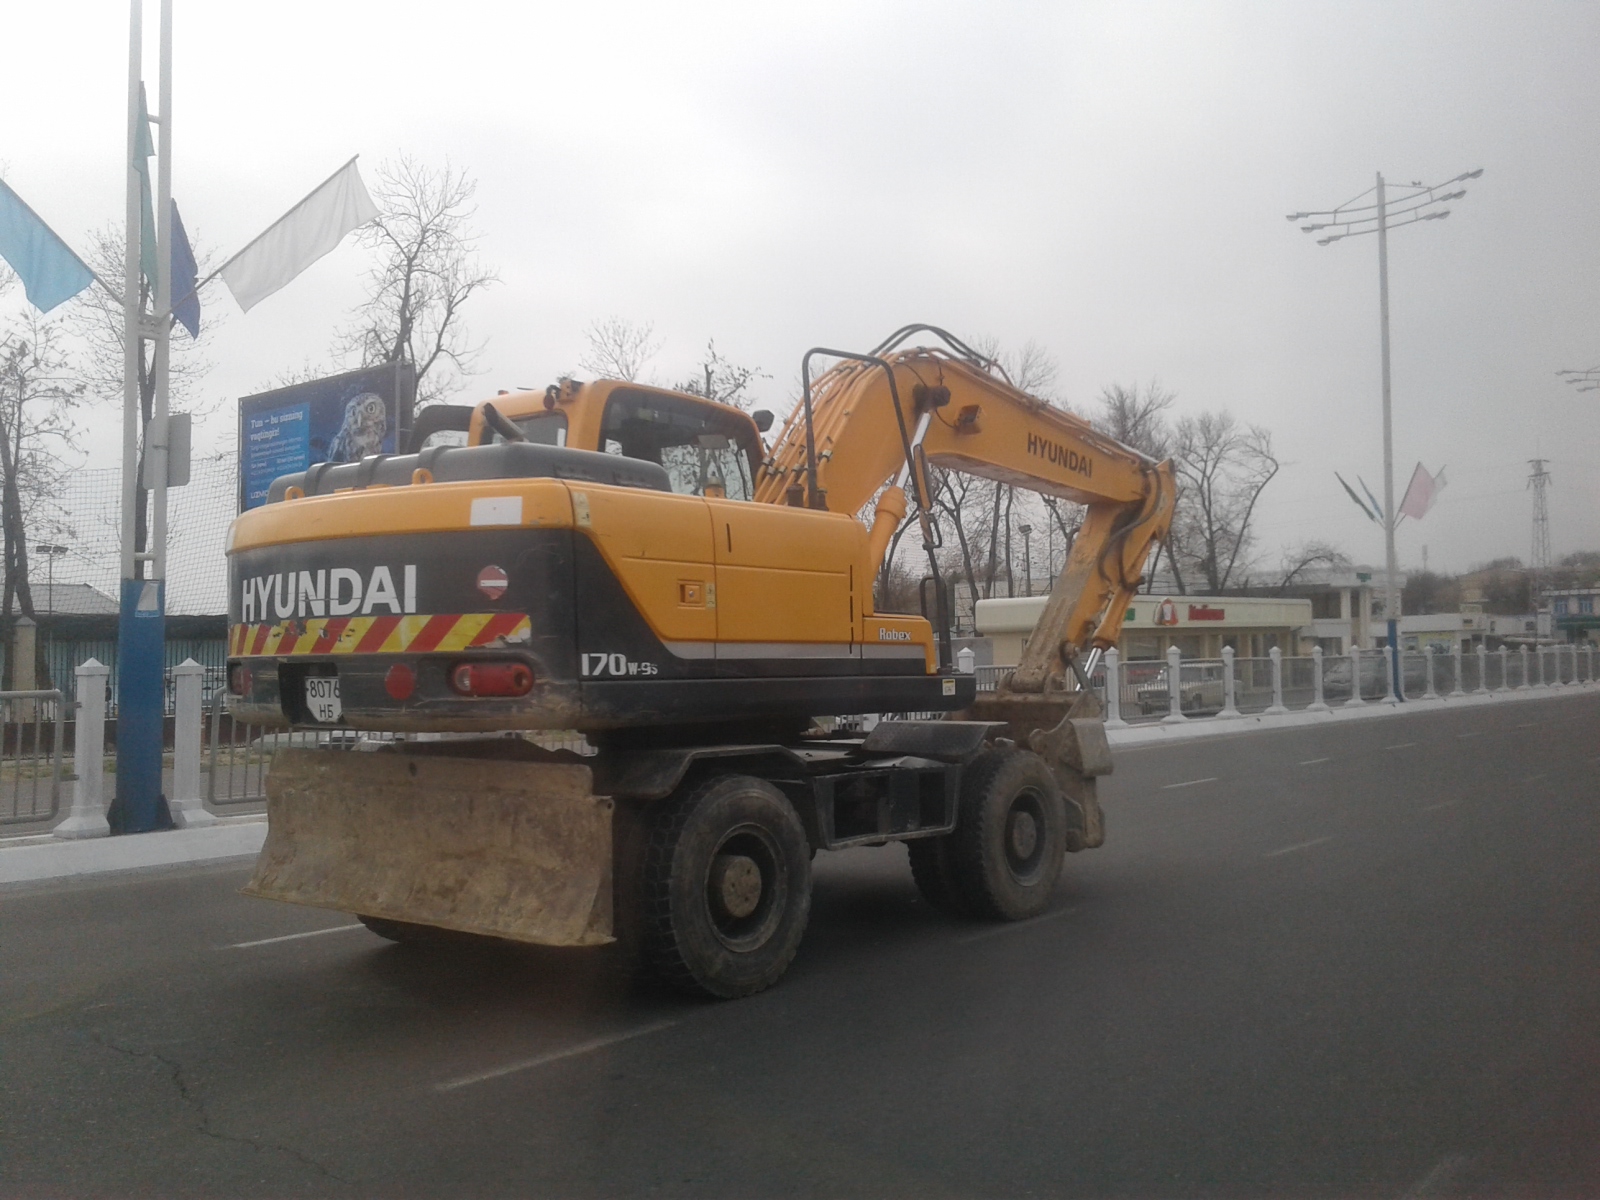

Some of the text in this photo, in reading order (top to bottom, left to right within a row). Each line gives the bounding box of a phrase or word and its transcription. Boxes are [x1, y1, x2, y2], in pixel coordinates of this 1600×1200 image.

[1027, 432, 1092, 478] HYUNDAI
[241, 564, 417, 623] HYUNDAI
[879, 627, 912, 640] Robex
[309, 680, 341, 699] 8076
